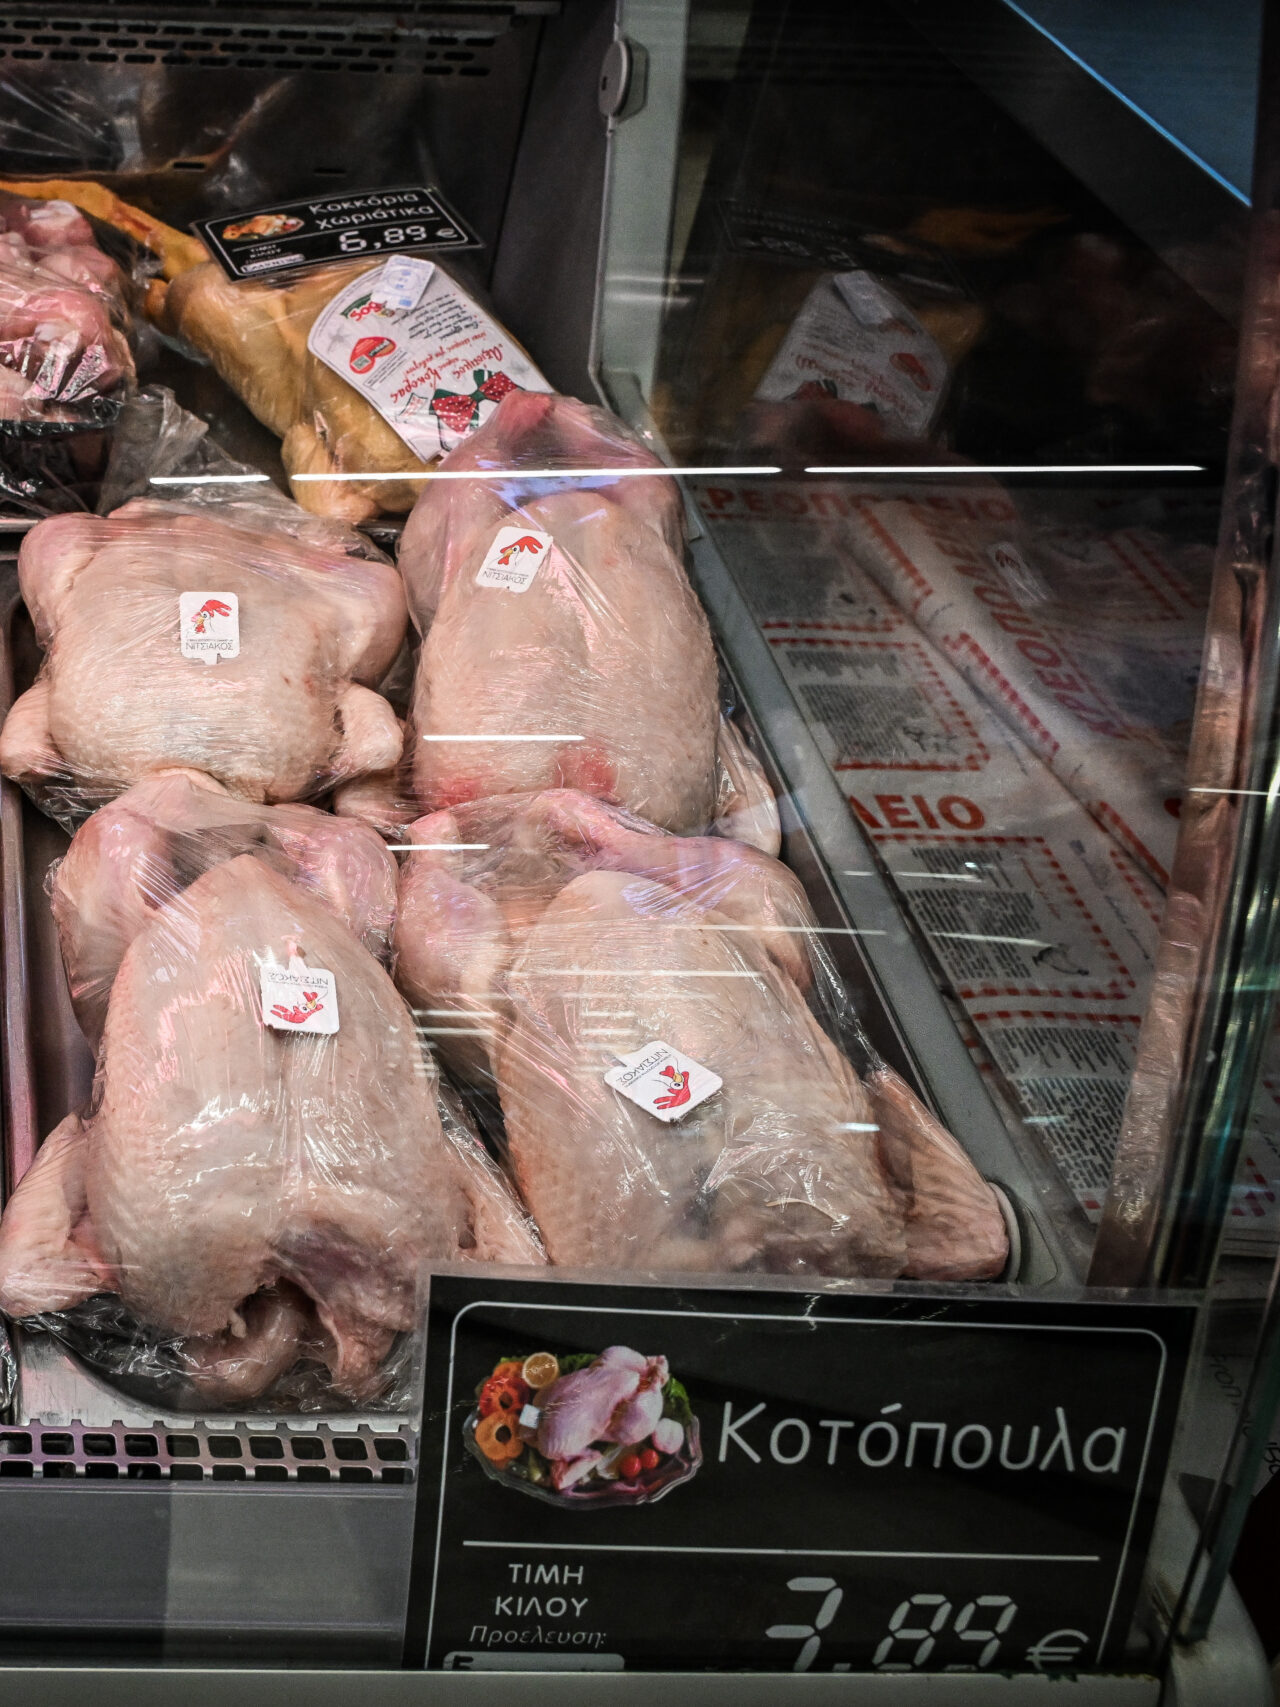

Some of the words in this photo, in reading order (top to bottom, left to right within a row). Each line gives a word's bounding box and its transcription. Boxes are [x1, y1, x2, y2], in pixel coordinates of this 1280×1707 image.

[308, 192, 420, 215] Κοκκόρια
[338, 225, 428, 252] 6,89
[718, 1401, 1126, 1474] Κοτόπουλα
[508, 1563, 584, 1585] ΤΙΜΗ
[495, 1596, 588, 1618] ΚΙΛΟΥ
